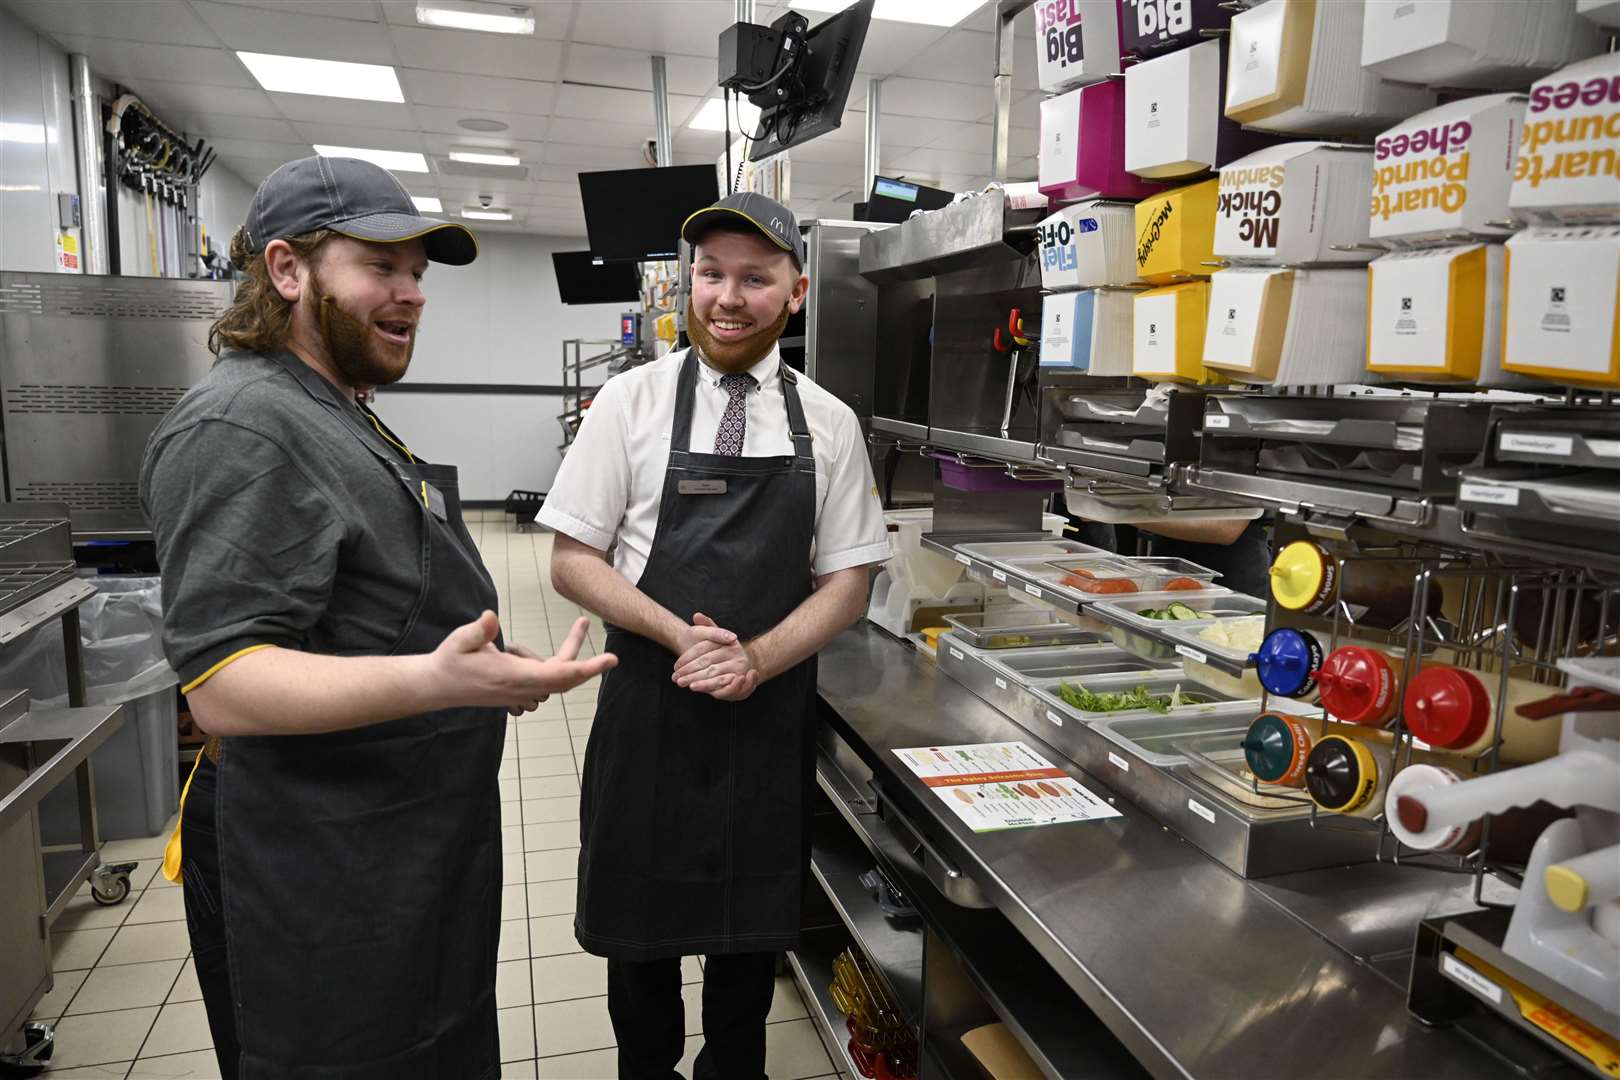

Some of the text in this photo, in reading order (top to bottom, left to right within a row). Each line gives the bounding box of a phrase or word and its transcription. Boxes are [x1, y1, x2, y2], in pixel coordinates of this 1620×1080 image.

[1039, 0, 1081, 35] Tast
[1137, 0, 1192, 40] Big
[1047, 24, 1084, 68] Big
[1375, 121, 1472, 161] chees
[1513, 148, 1620, 190] uarte
[1217, 191, 1281, 218] Chick
[1370, 183, 1467, 222] Quarte
[1137, 200, 1173, 268] McCrispy
[1239, 217, 1280, 248] Mc
[1042, 245, 1078, 272] Filet
[1320, 565, 1335, 600] Smoky
